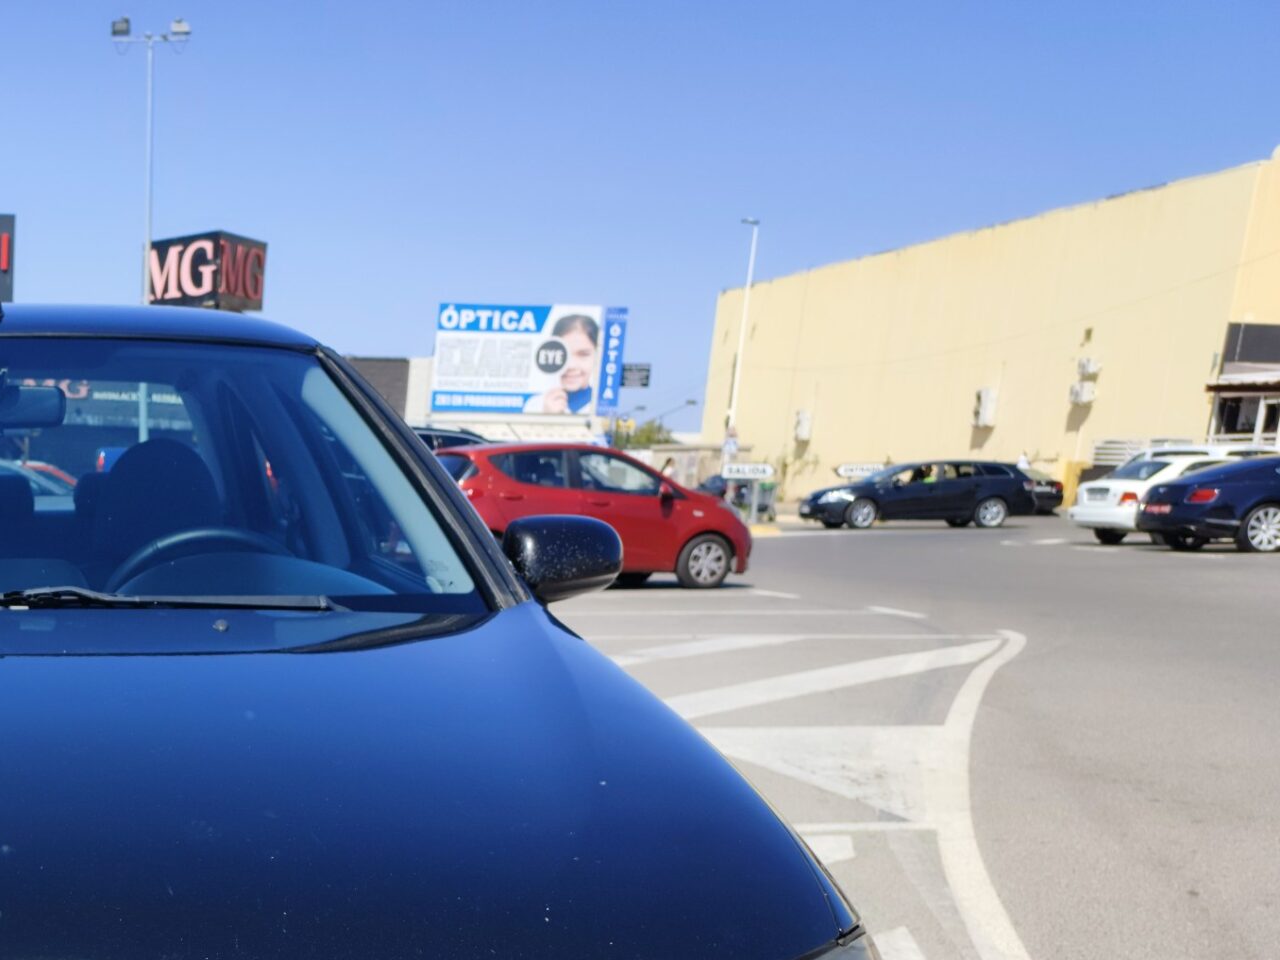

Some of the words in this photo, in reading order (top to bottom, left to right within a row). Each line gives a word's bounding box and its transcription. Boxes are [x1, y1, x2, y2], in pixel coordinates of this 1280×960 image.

[149, 239, 217, 301] MG
[218, 240, 265, 300] MG
[440, 303, 538, 331] ÓPTICA
